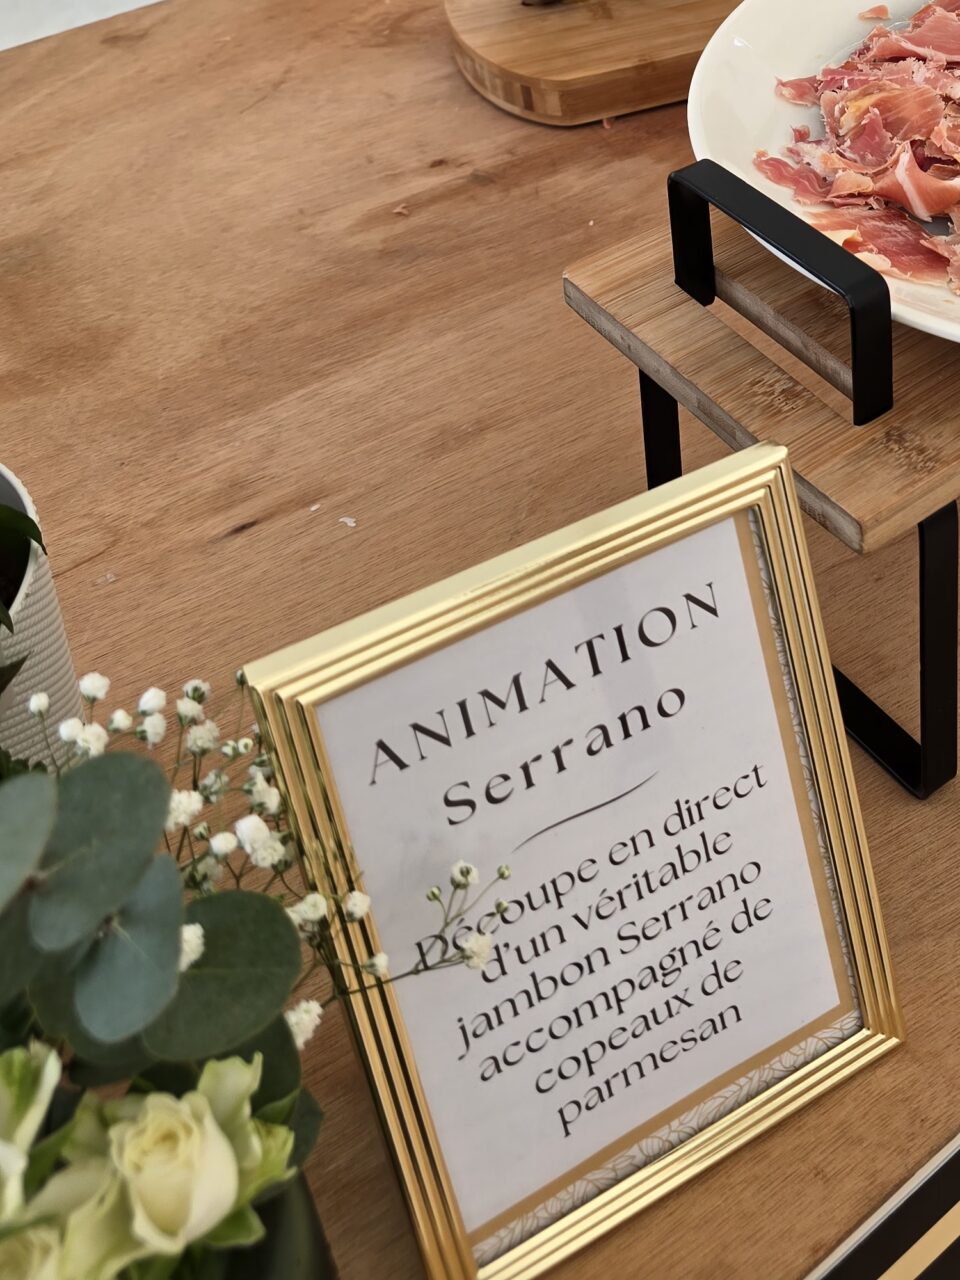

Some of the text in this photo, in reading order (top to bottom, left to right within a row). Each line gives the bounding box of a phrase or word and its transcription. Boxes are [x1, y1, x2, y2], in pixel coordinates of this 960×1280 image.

[369, 581, 721, 787] ANIMATION
[442, 687, 686, 827] Serrano
[415, 764, 768, 971] Découpe en direct
[571, 830, 733, 932] véritable
[456, 860, 763, 1062] jambon Serrano
[479, 897, 774, 1083] accompagné de
[534, 959, 744, 1095] copeaux de
[557, 1004, 743, 1139] parmesan
